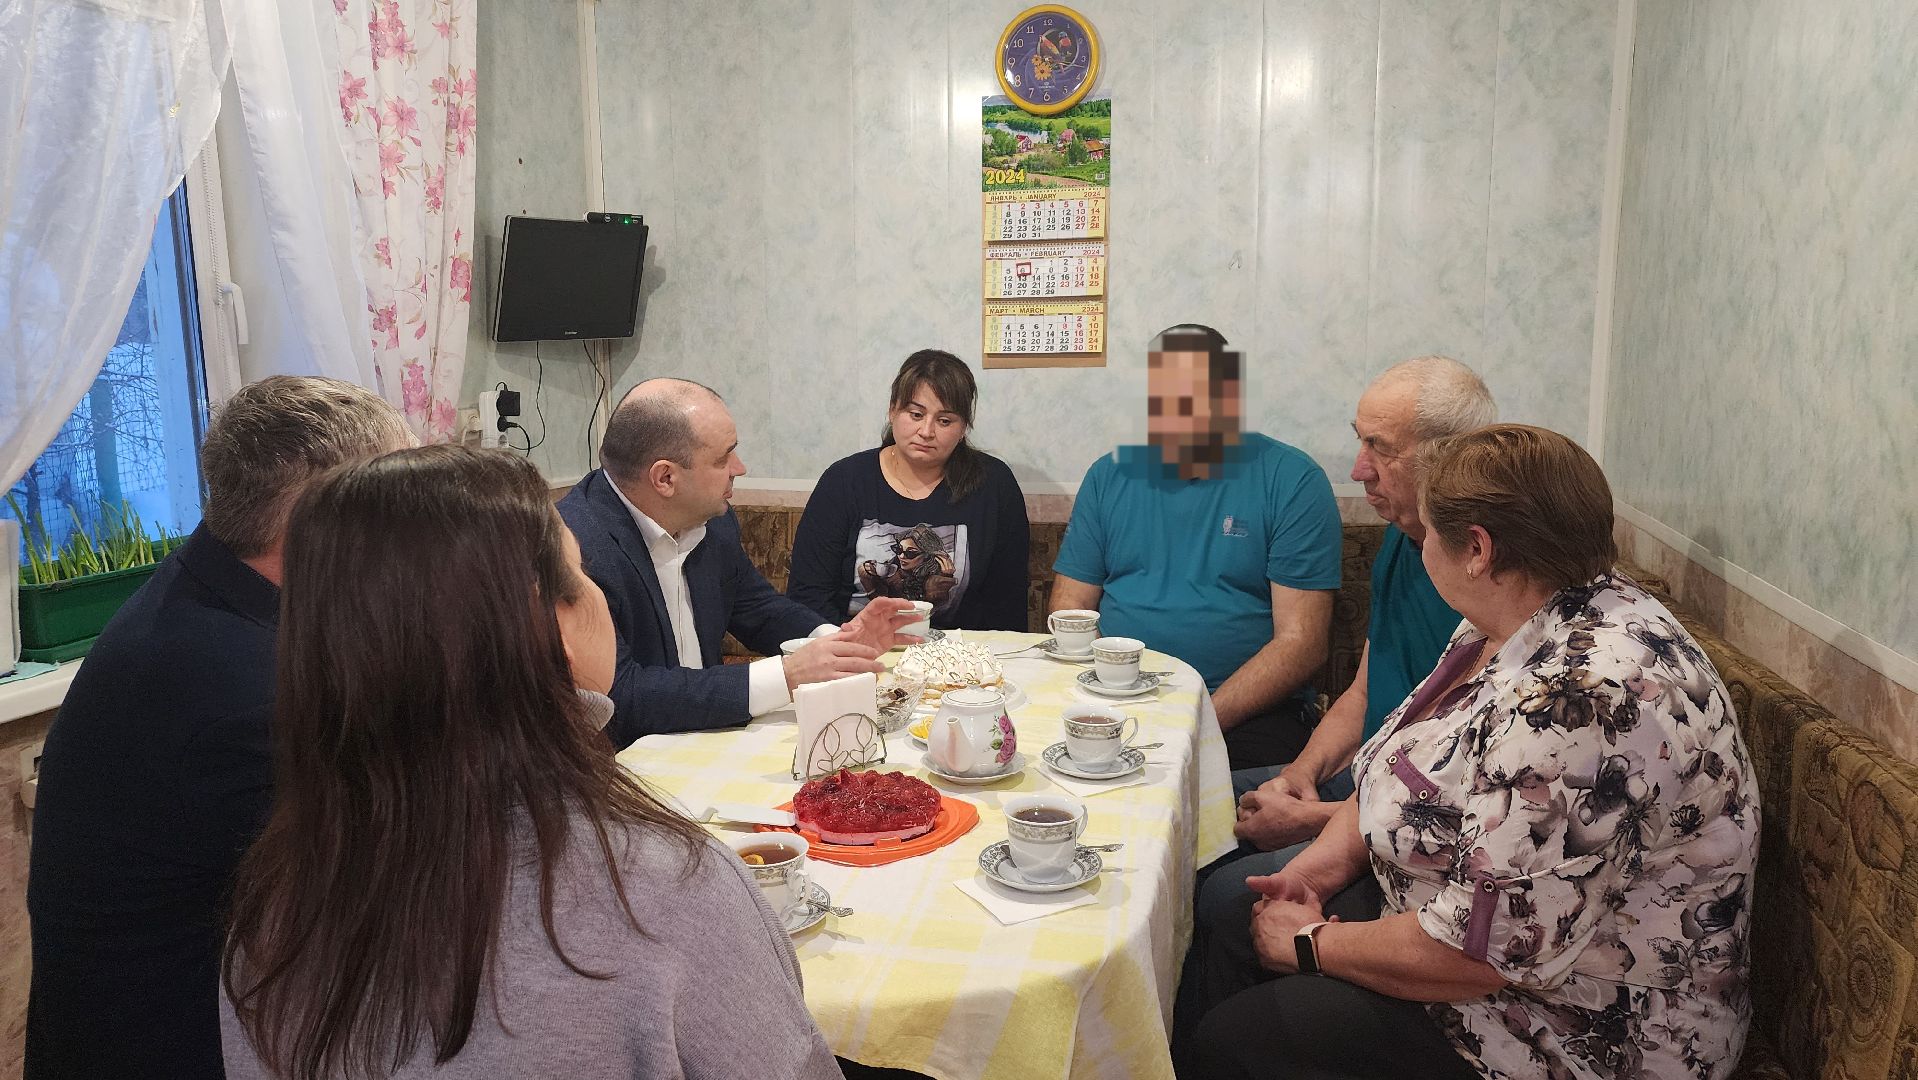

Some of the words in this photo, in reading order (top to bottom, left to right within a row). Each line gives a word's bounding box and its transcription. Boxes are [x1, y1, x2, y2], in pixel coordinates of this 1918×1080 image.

[1026, 26, 1034, 34] 11
[1013, 39, 1024, 48] 10
[1008, 57, 1016, 68] 9
[1081, 55, 1087, 63] 3
[1014, 75, 1022, 87] 8
[1028, 88, 1034, 98] 7
[1043, 92, 1050, 102] 6
[985, 168, 1026, 186] 2024
